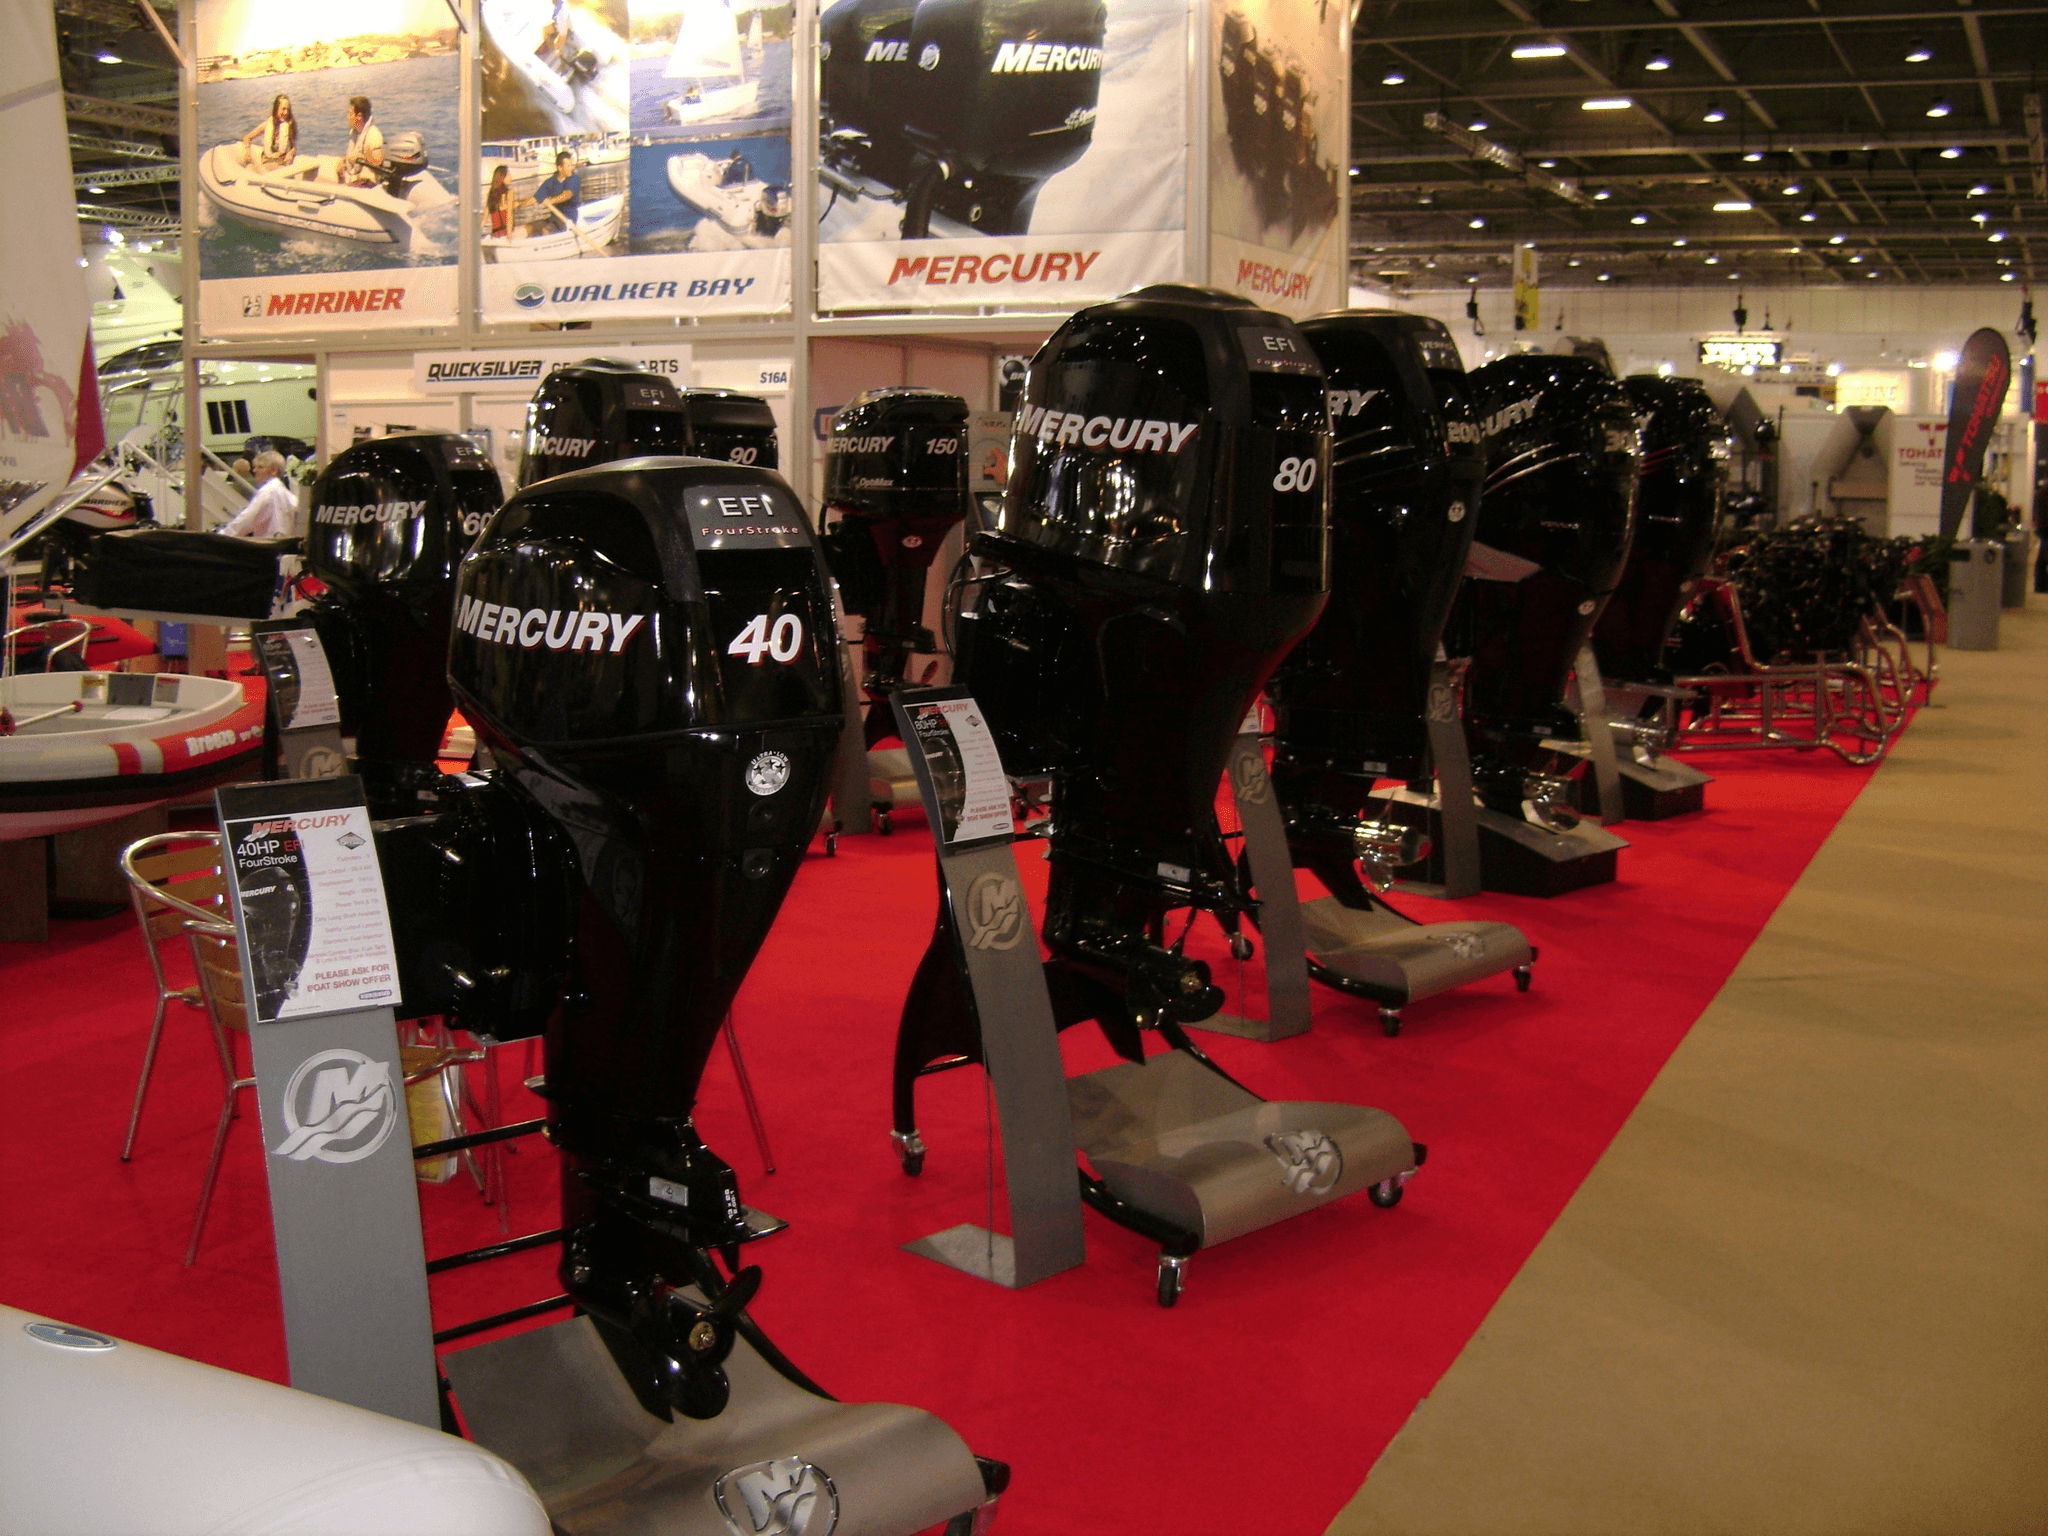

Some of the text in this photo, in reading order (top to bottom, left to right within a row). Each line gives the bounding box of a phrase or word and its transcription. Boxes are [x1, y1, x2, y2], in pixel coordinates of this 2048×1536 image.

[887, 252, 1101, 286] MERCURY
[1236, 259, 1313, 301] MERCURY
[551, 278, 754, 303] WALKER BAY
[266, 288, 405, 316] MARINER
[1262, 336, 1297, 353] EFI
[427, 359, 543, 380] QUICKSILVER
[760, 372, 787, 384] S16A
[639, 388, 664, 399] EFI
[1328, 390, 1379, 417] RY
[1016, 404, 1198, 454] MERCURY
[535, 437, 596, 458] RCURY
[728, 447, 757, 465] 90
[926, 438, 958, 455] 150
[1898, 448, 1943, 459] TOHAT
[1272, 457, 1317, 493] 80
[315, 500, 426, 525] MERCURY
[717, 495, 774, 516] EFI
[463, 512, 493, 536] 60
[701, 526, 799, 536] FourStroke
[457, 594, 645, 653] MERCURY
[727, 613, 804, 665] 40
[919, 703, 968, 715] MERCURY
[251, 814, 351, 834] MERCURY
[237, 839, 306, 857] 40HP EFI
[239, 854, 298, 869] FourStroke
[240, 885, 277, 897] MERCURY
[315, 963, 390, 980] PLEASE ASK FOR
[307, 974, 391, 992] BOAT SHOW OFFER
